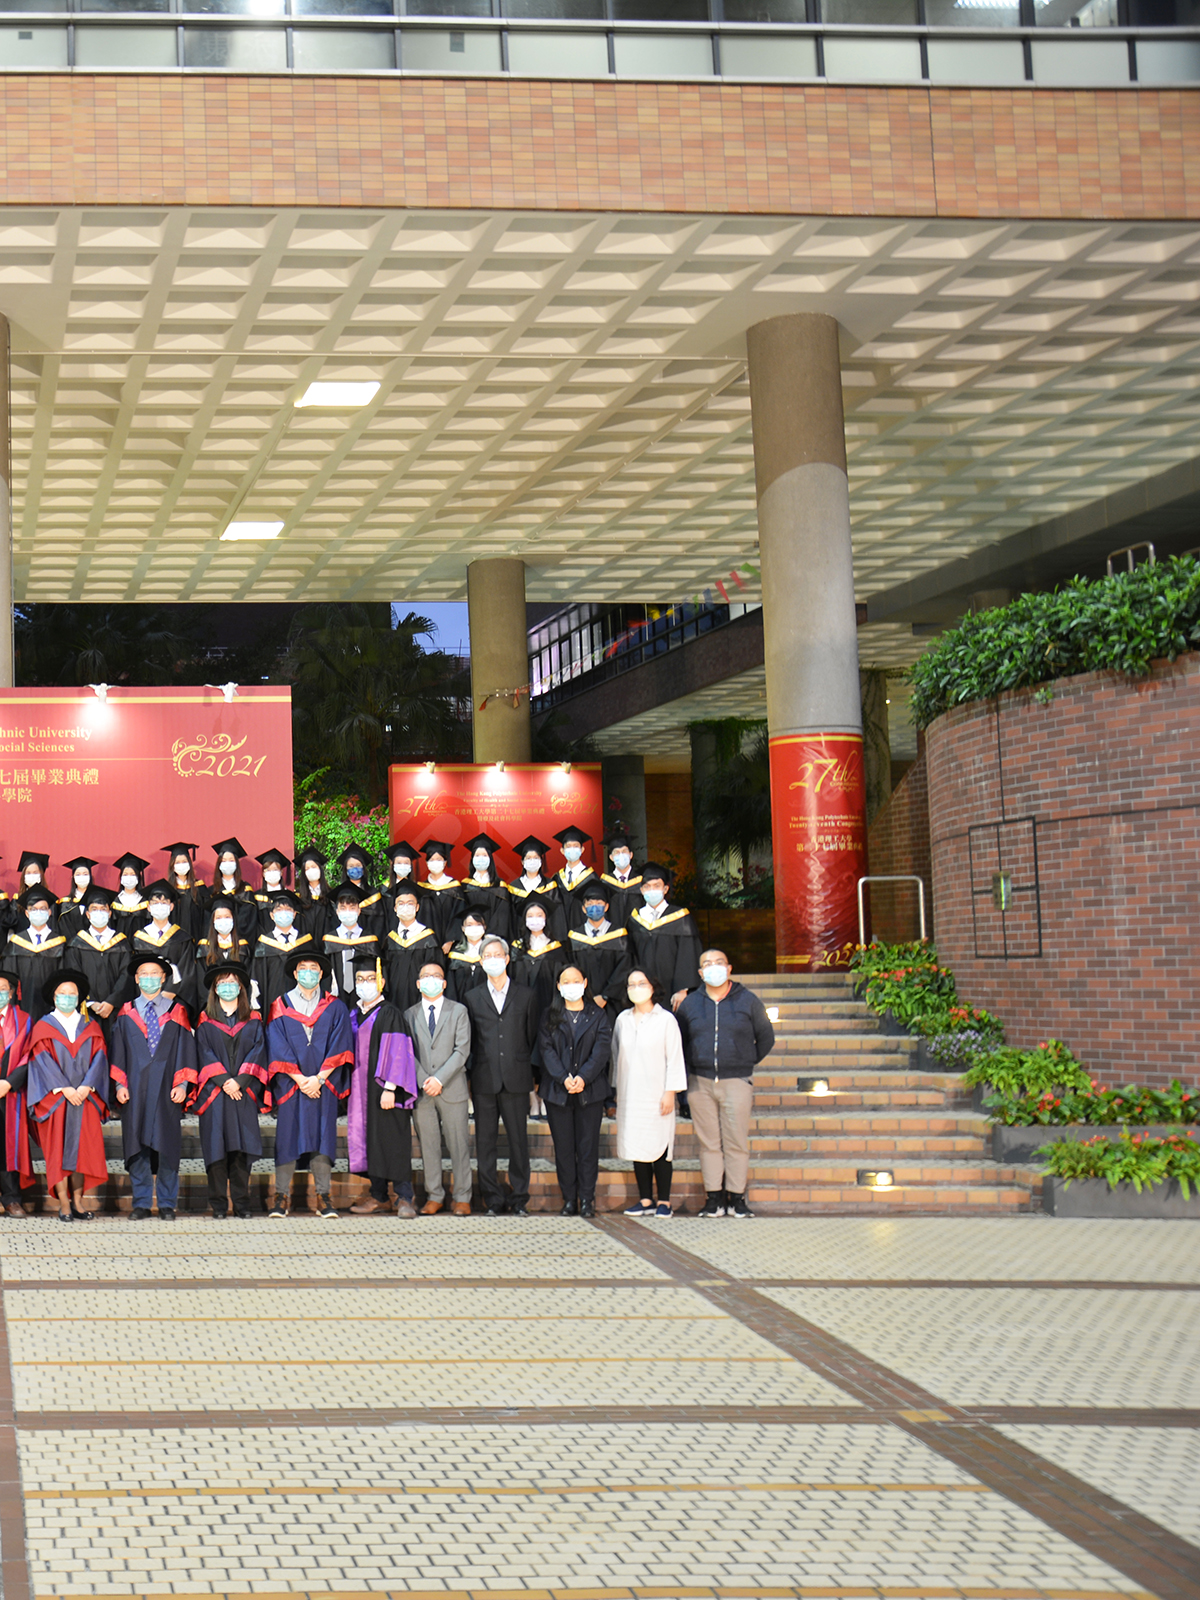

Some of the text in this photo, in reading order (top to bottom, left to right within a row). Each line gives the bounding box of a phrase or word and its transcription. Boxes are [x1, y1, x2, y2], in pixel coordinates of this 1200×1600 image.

[29, 726, 92, 741] University
[28, 742, 75, 752] Sciences
[195, 754, 267, 778] 2021
[789, 750, 859, 793] 27th
[397, 789, 449, 817] 27th
